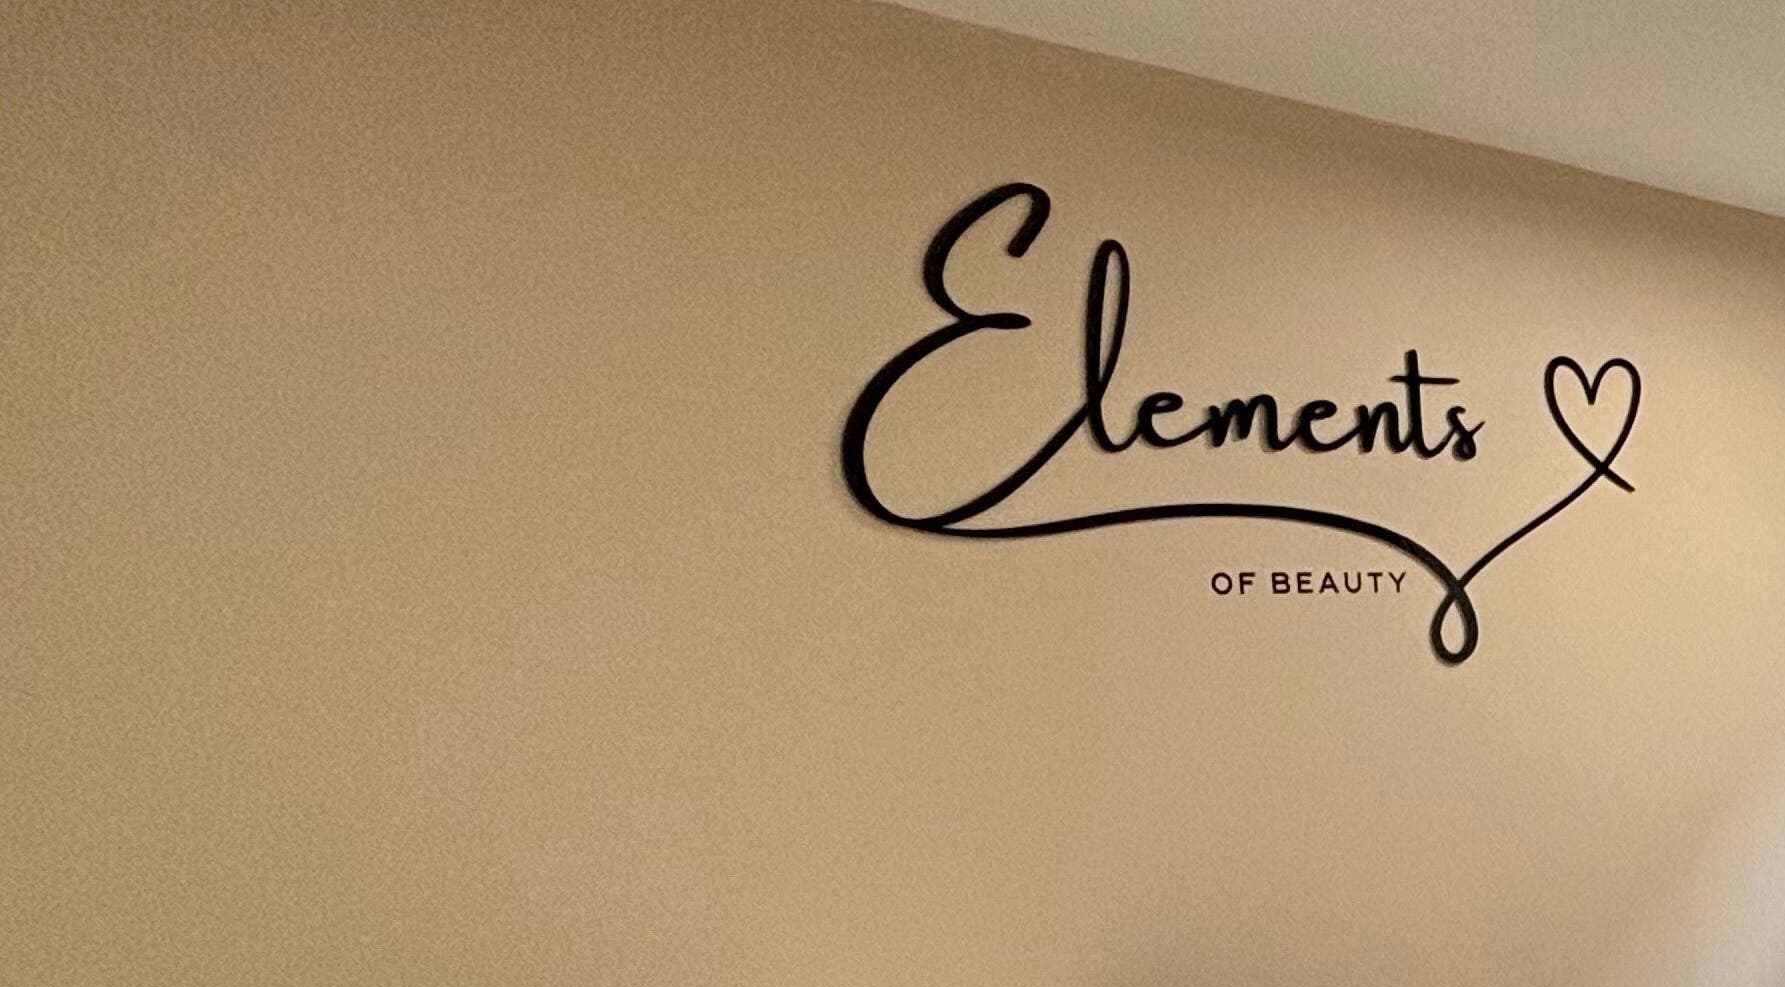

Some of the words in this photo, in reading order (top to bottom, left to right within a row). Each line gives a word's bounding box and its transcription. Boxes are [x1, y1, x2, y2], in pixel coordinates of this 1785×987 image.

[841, 183, 1484, 537] Elements
[1211, 572, 1256, 595] OF
[1271, 571, 1407, 594] BEAUTY
